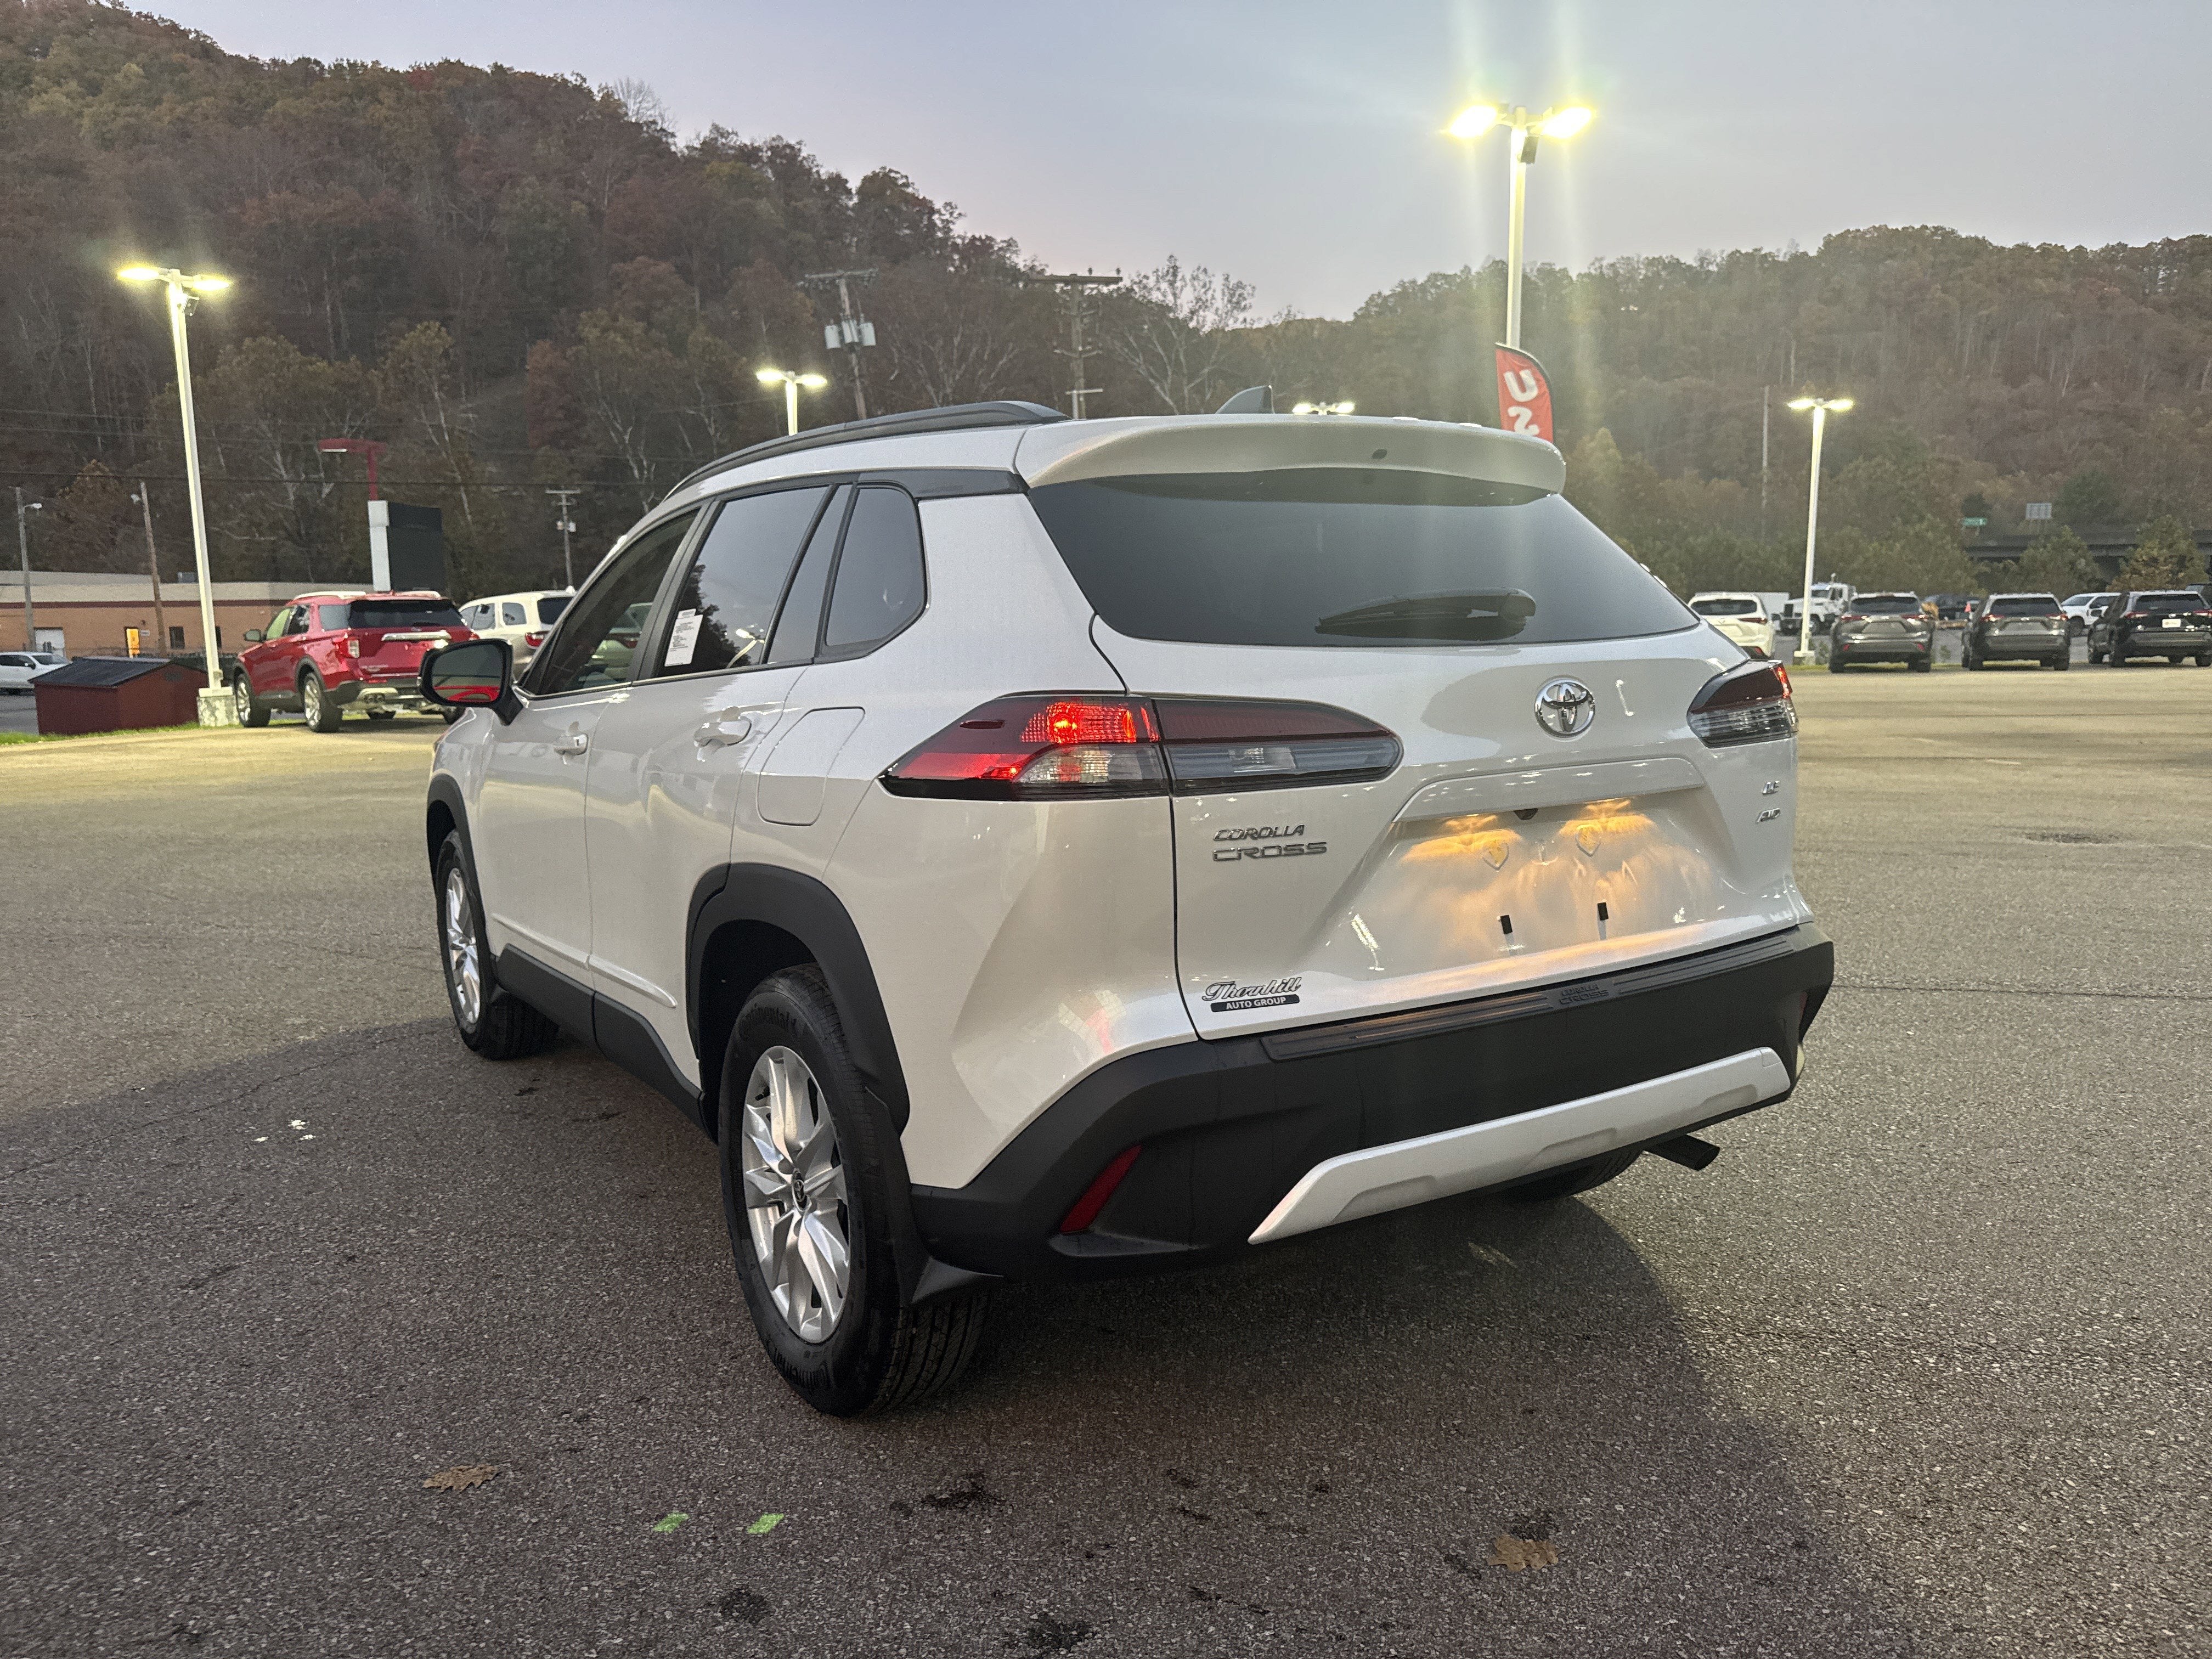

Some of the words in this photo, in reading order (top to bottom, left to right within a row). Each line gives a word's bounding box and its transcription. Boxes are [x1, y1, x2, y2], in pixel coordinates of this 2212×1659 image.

[1214, 824, 1305, 841] COROLLA
[1213, 842, 1327, 861] CROSS
[1202, 977, 1302, 1001] Thornhill
[1559, 990, 1609, 1005] CROSS
[1226, 1000, 1252, 1010] AUTO
[1254, 996, 1286, 1007] GROUP
